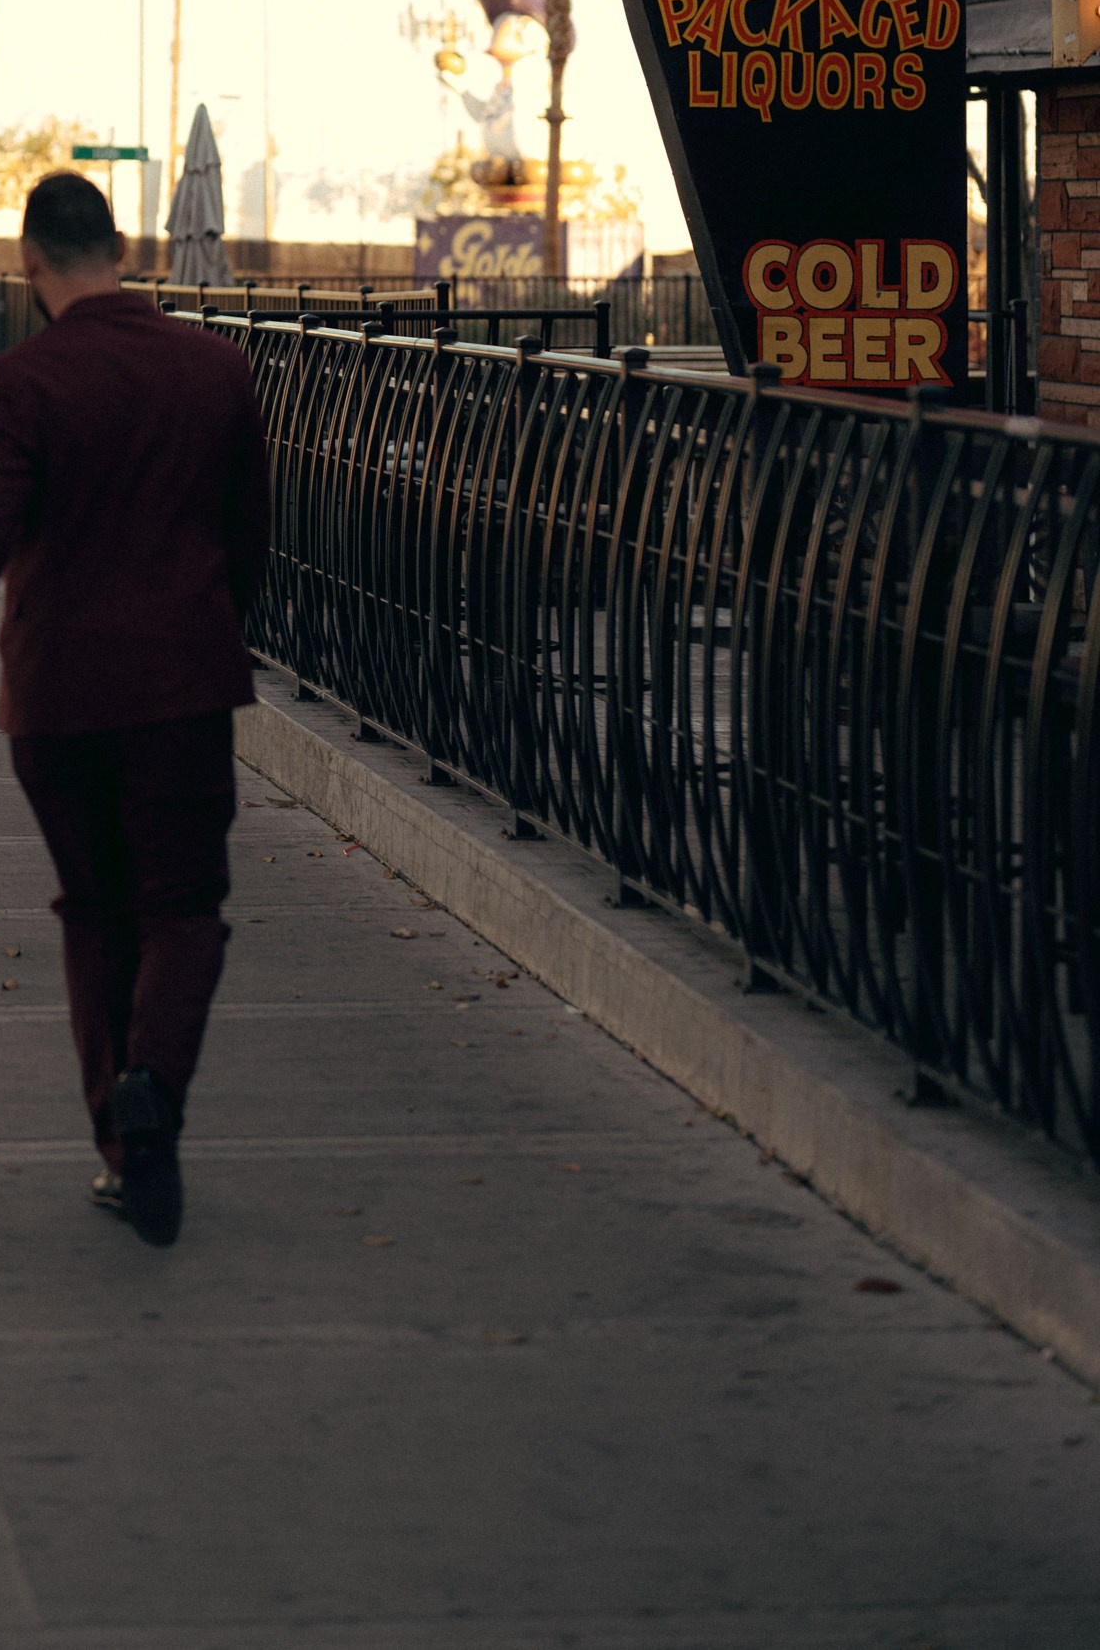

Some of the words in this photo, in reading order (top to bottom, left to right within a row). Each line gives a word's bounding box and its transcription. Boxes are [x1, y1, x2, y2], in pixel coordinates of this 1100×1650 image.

[688, 50, 927, 122] LIQUORS
[439, 220, 546, 279] Golde
[742, 238, 959, 315] COLD
[757, 311, 954, 387] BEER
